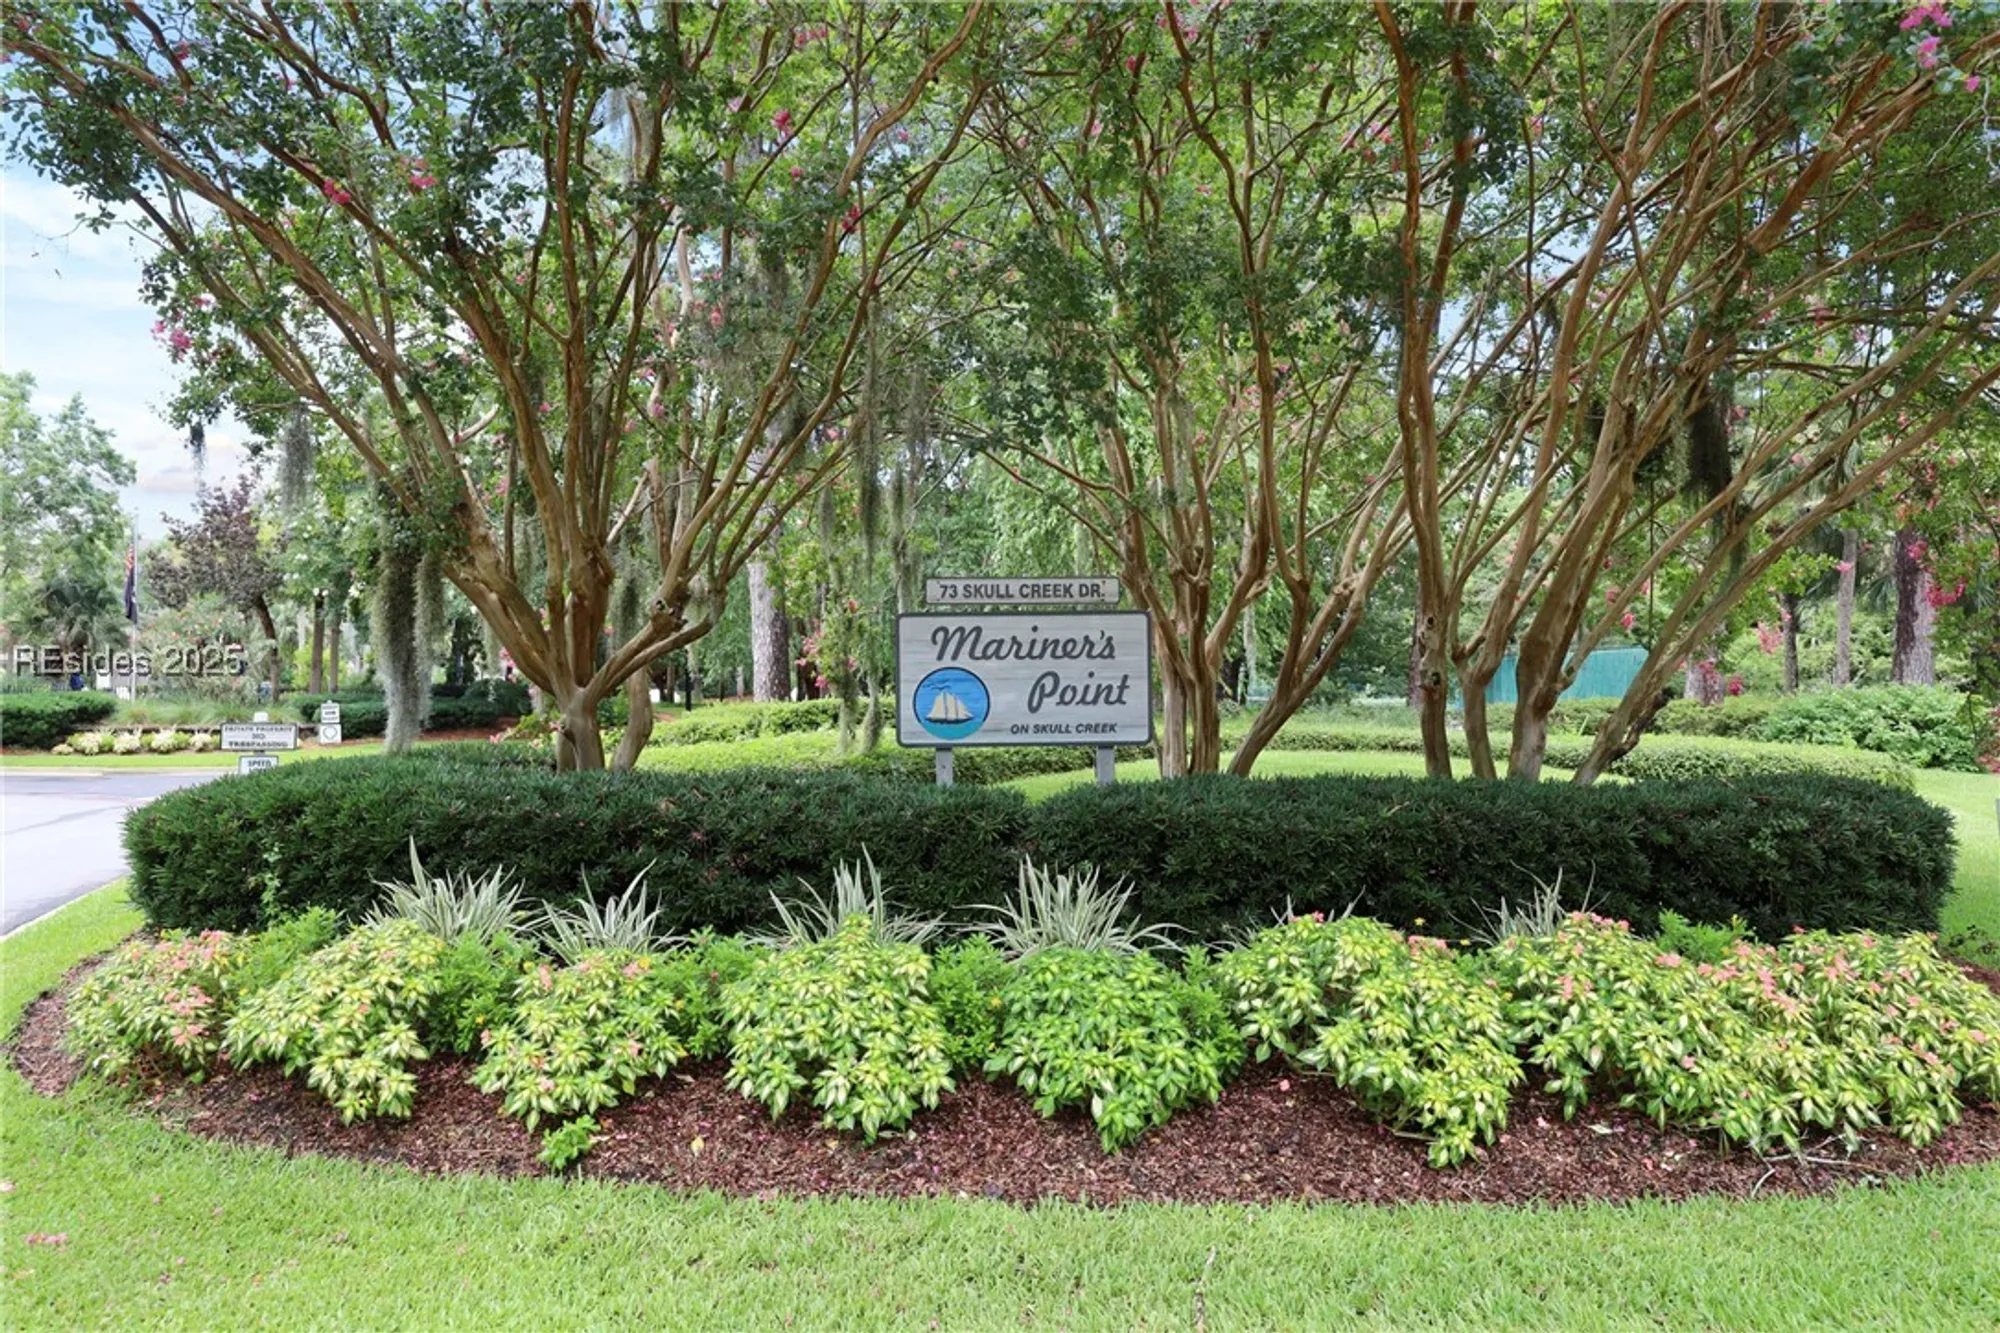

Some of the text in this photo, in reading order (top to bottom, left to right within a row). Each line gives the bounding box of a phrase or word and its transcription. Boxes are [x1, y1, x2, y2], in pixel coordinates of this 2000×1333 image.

[940, 584, 958, 599] 73
[962, 583, 1014, 598] SKULL
[1019, 583, 1074, 599] CREEK
[931, 625, 1116, 662] Mariner's
[1027, 671, 1130, 714] Point
[1010, 722, 1118, 735] ON SKULL CREEK
